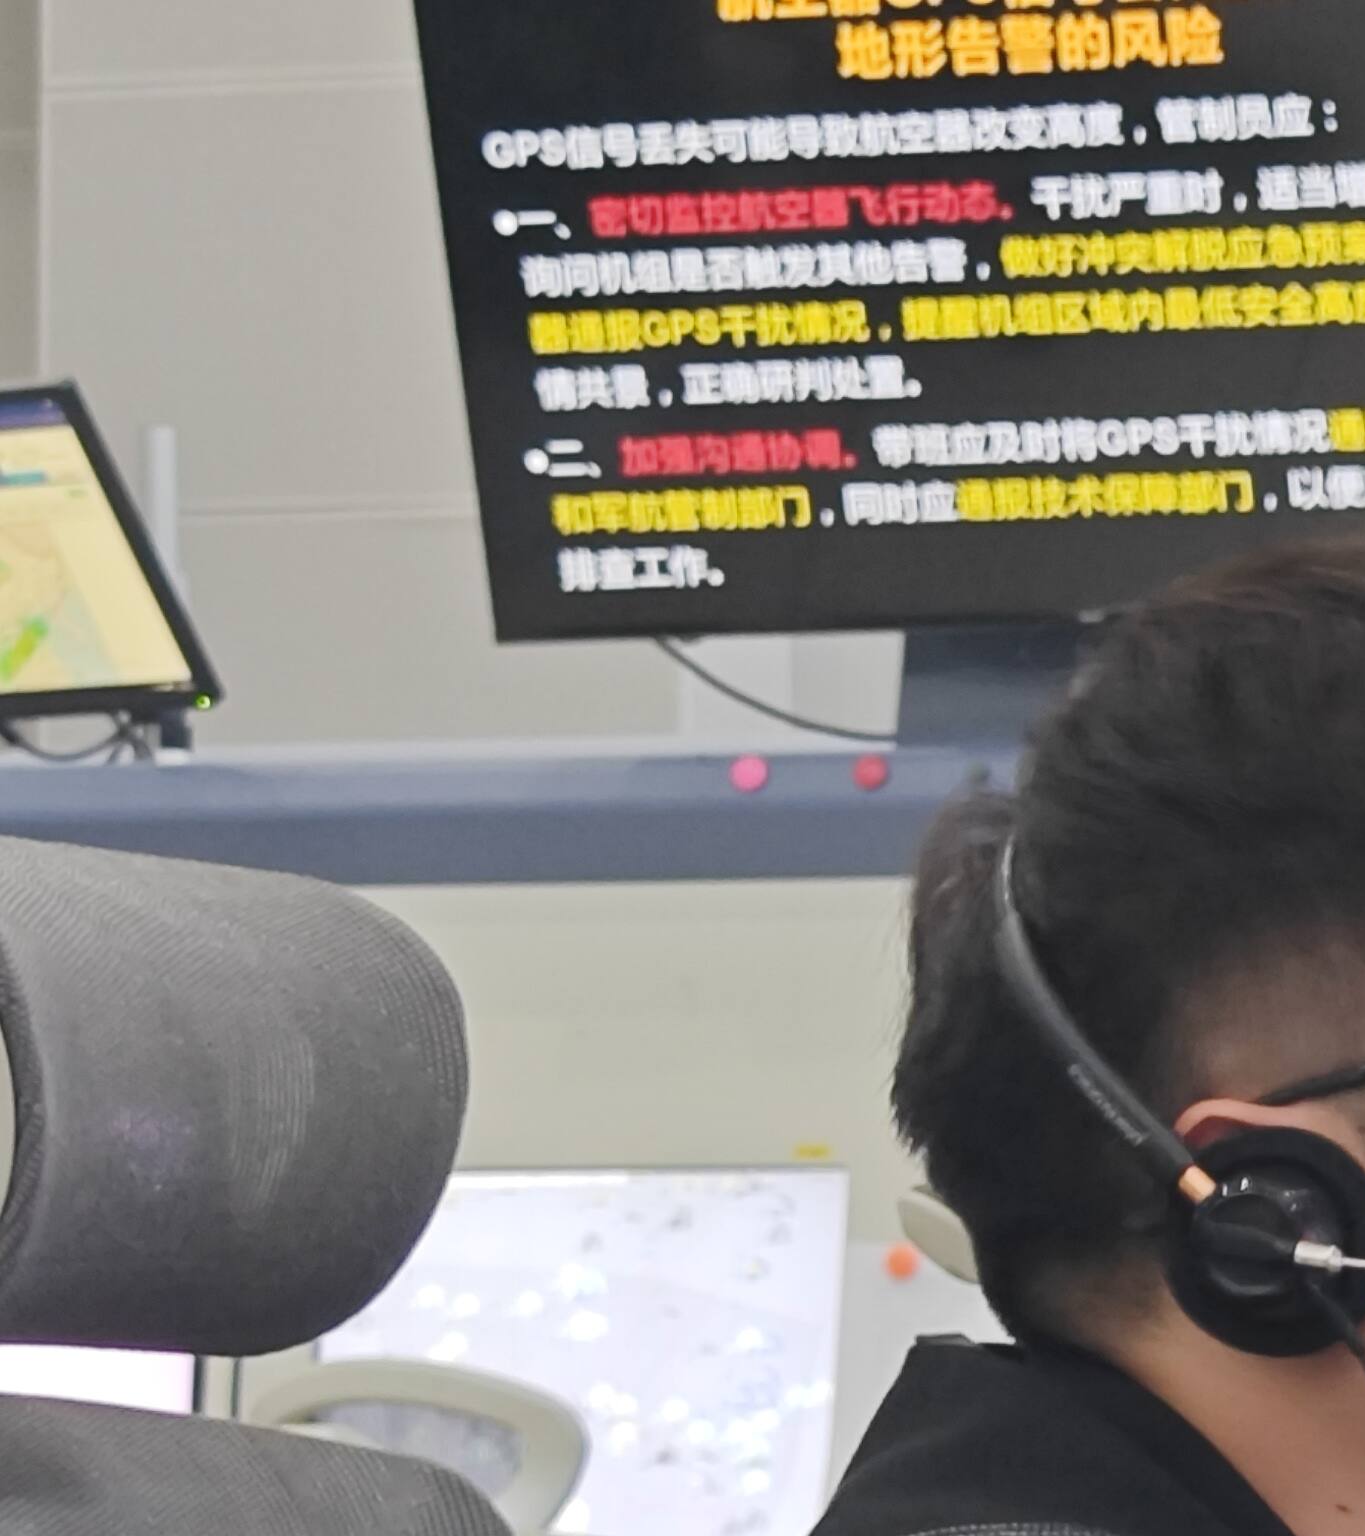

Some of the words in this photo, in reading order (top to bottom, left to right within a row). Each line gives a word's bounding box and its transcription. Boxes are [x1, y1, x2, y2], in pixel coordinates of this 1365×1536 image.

[835, 7, 1225, 81] 地形告警的风险
[556, 545, 725, 592] 排查工作。
